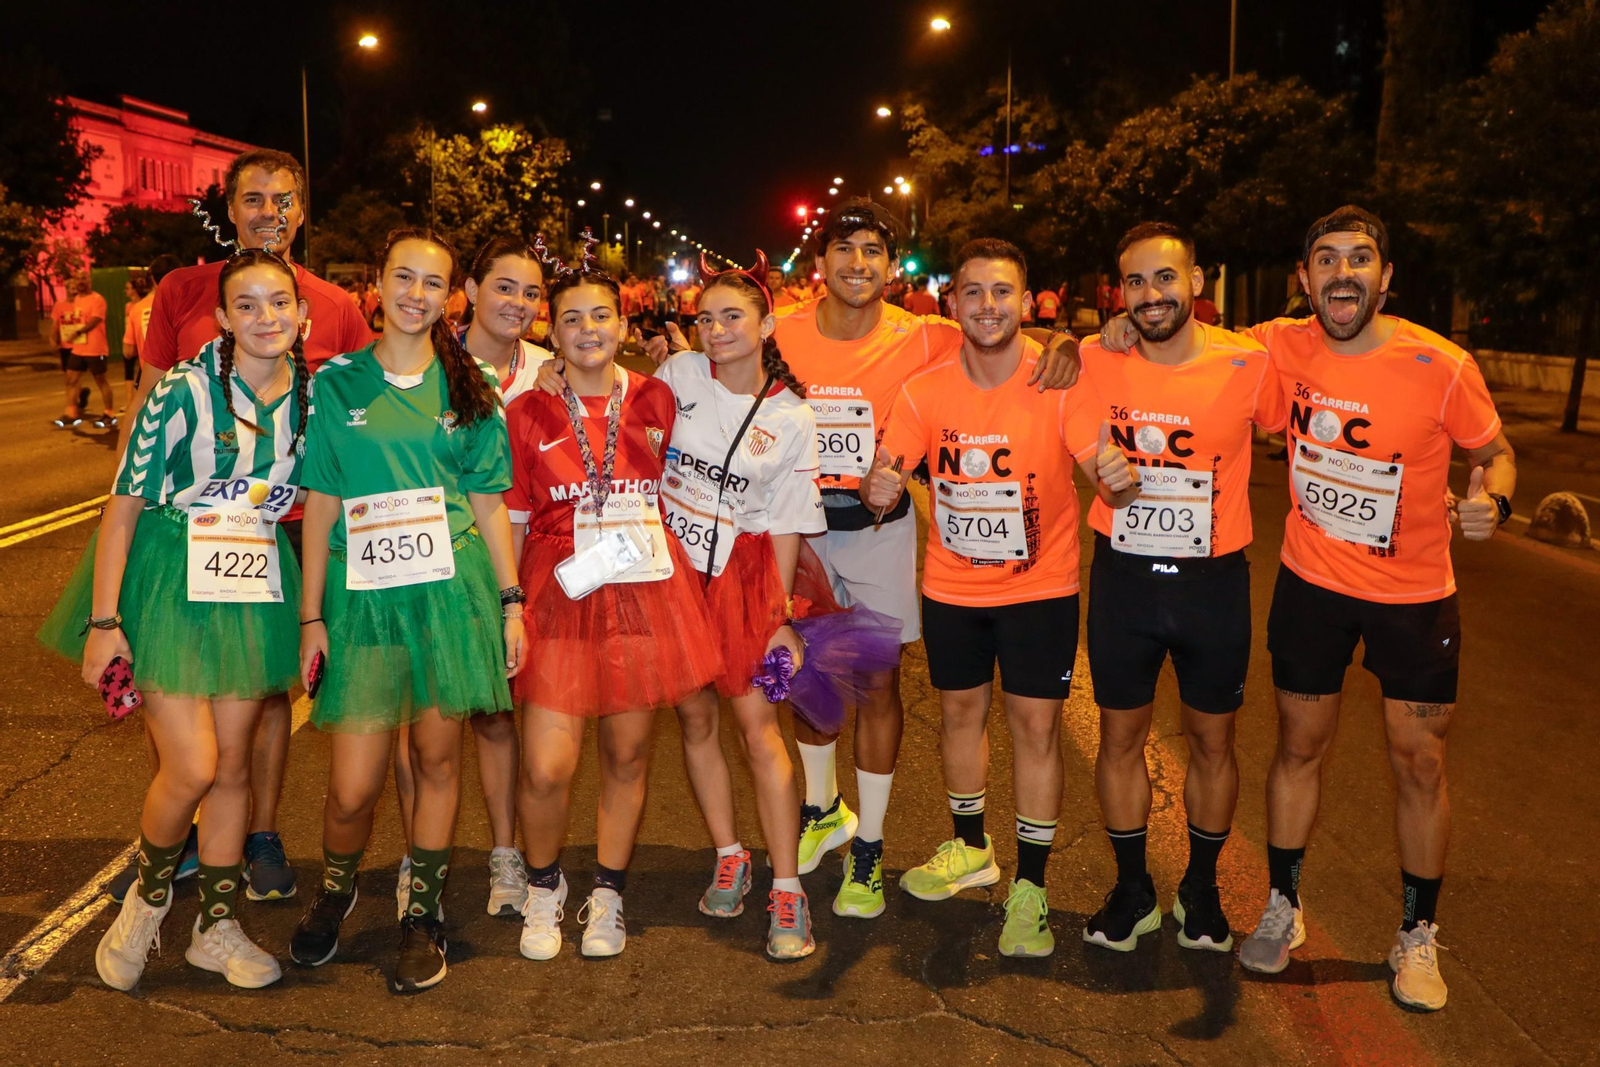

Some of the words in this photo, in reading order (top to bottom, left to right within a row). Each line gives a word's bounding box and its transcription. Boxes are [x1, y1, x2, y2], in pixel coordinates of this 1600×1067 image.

[809, 384, 863, 396] CARRERA
[1294, 382, 1311, 400] 36
[1311, 391, 1370, 415] CARRERA
[1110, 405, 1128, 420] 36
[1131, 409, 1191, 426] CARRERA
[940, 428, 959, 443] 36
[958, 433, 1009, 445] CARRERA
[1305, 481, 1378, 521] 5925
[947, 514, 1010, 539] 5704
[1125, 505, 1195, 533] 5703
[361, 532, 434, 566] 4350
[204, 551, 268, 579] 4222
[1152, 564, 1179, 573] FILA
[811, 822, 838, 832] saucony
